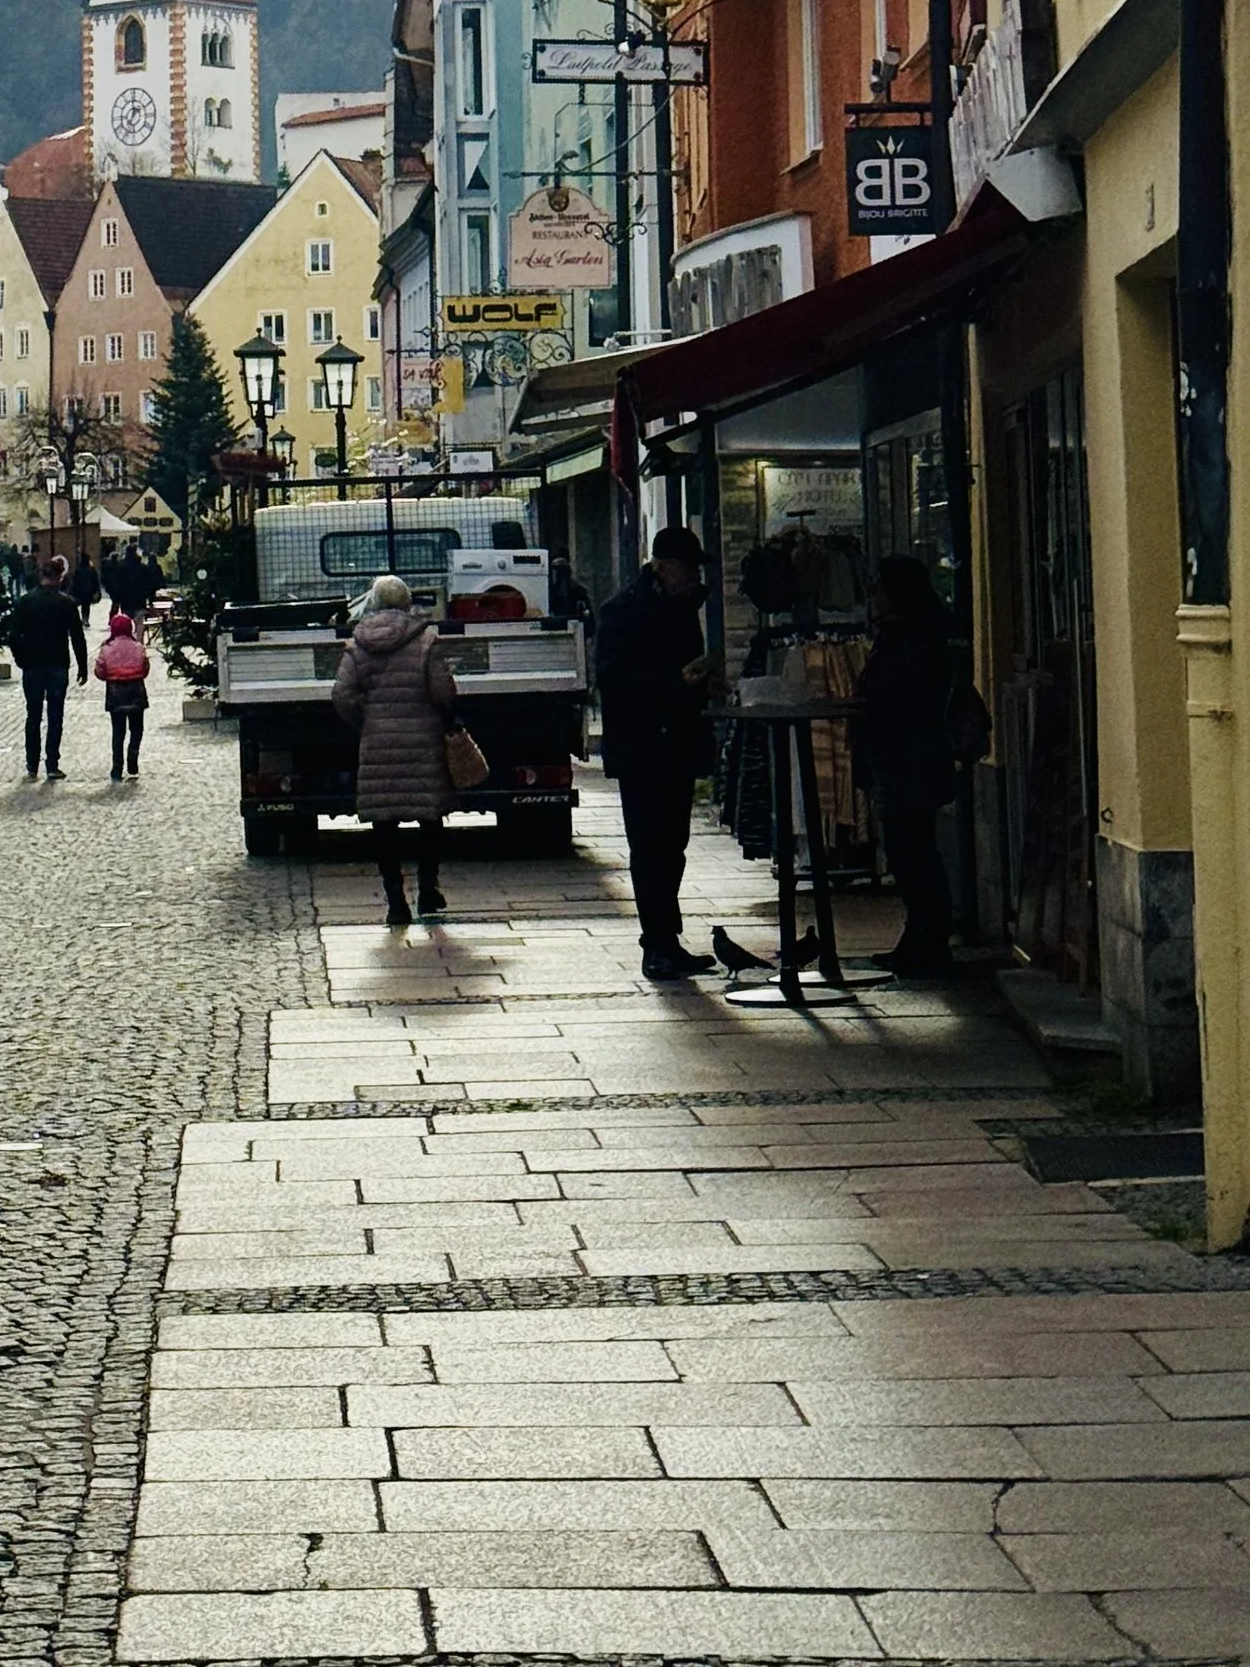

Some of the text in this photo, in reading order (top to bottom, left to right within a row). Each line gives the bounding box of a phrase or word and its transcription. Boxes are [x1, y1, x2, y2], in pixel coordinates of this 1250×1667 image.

[858, 208, 928, 220] BIJOU BRIGITTE
[532, 230, 589, 241] RESTAURANT
[514, 248, 603, 269] Asia Garten
[447, 302, 558, 324] WOLF
[511, 794, 570, 804] CANTER
